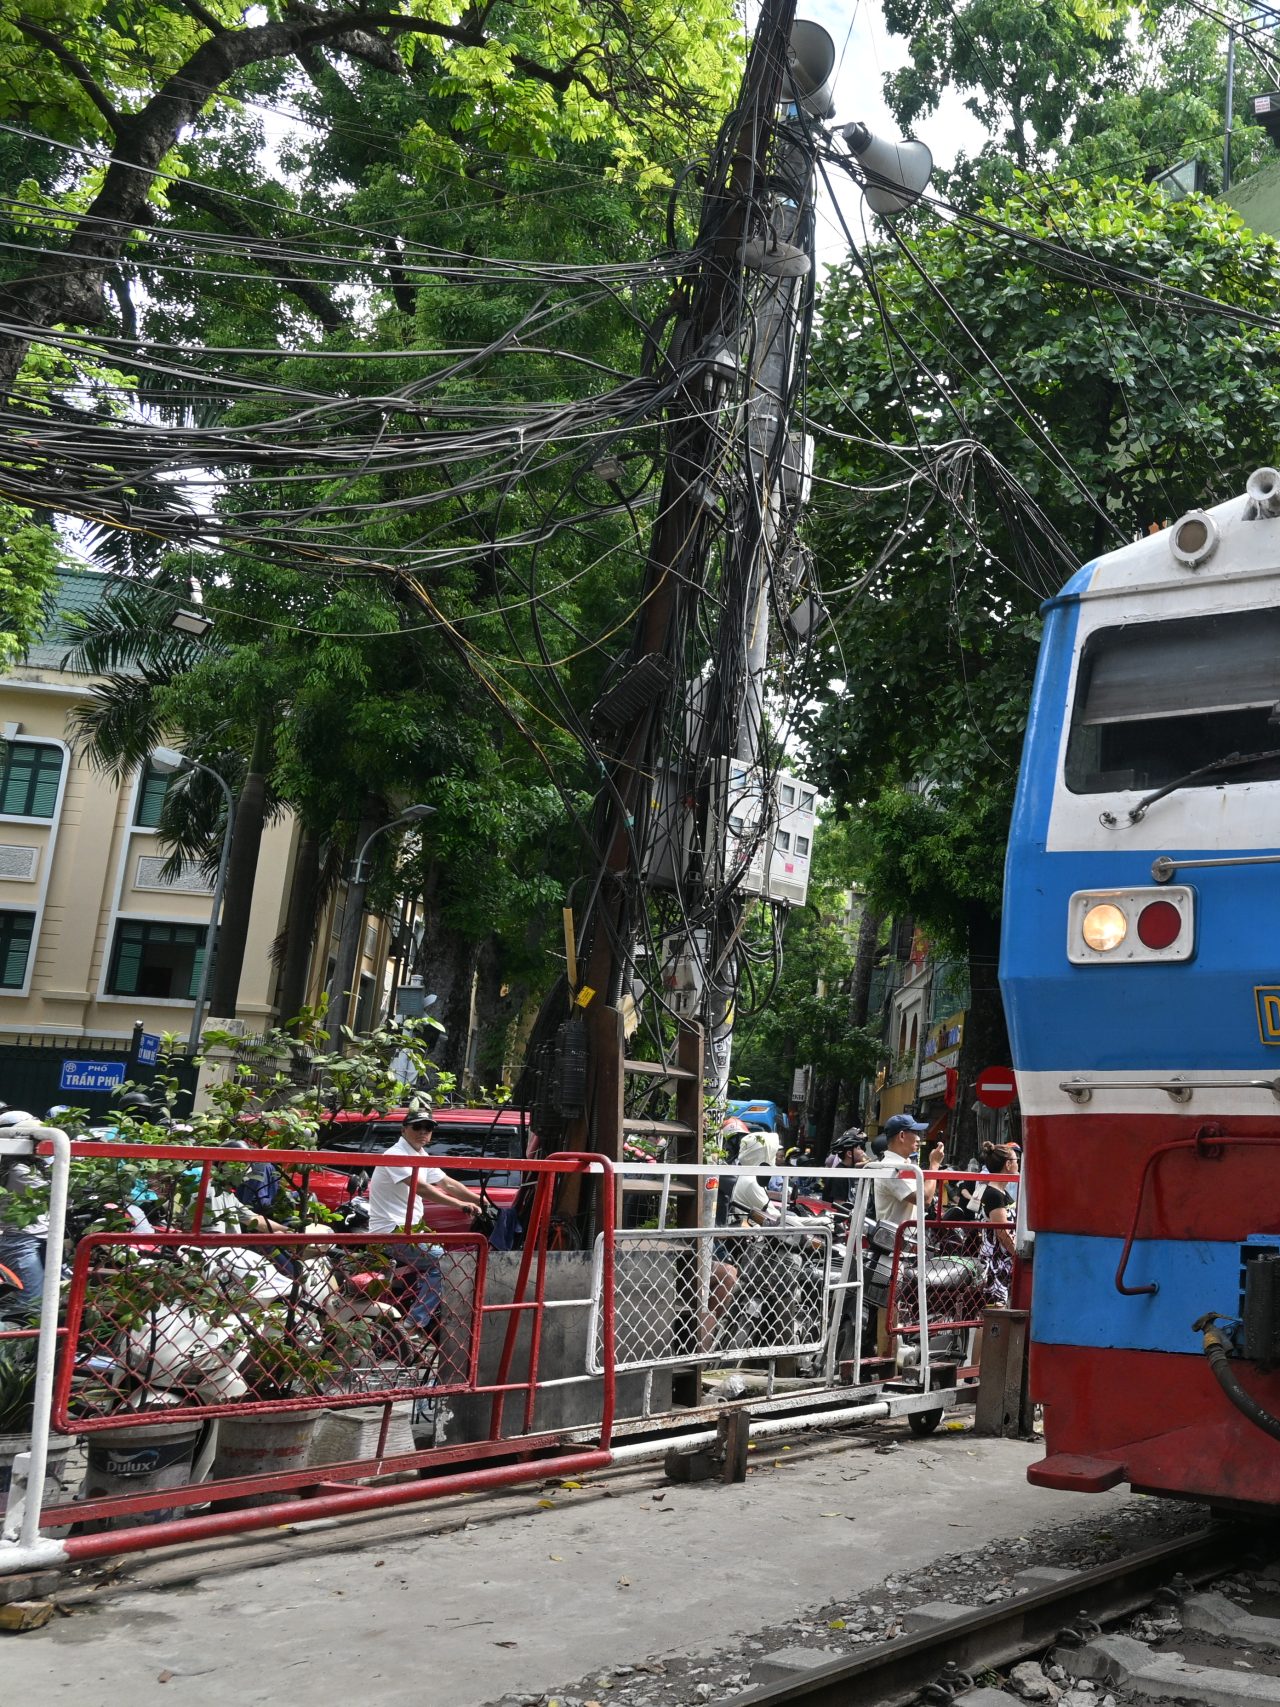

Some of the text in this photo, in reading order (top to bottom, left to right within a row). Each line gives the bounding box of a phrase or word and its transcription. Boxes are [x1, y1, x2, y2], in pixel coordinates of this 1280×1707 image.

[88, 1064, 108, 1072] PHỐ
[97, 1074, 120, 1087] PHÚ
[106, 1461, 152, 1472] Dulux
